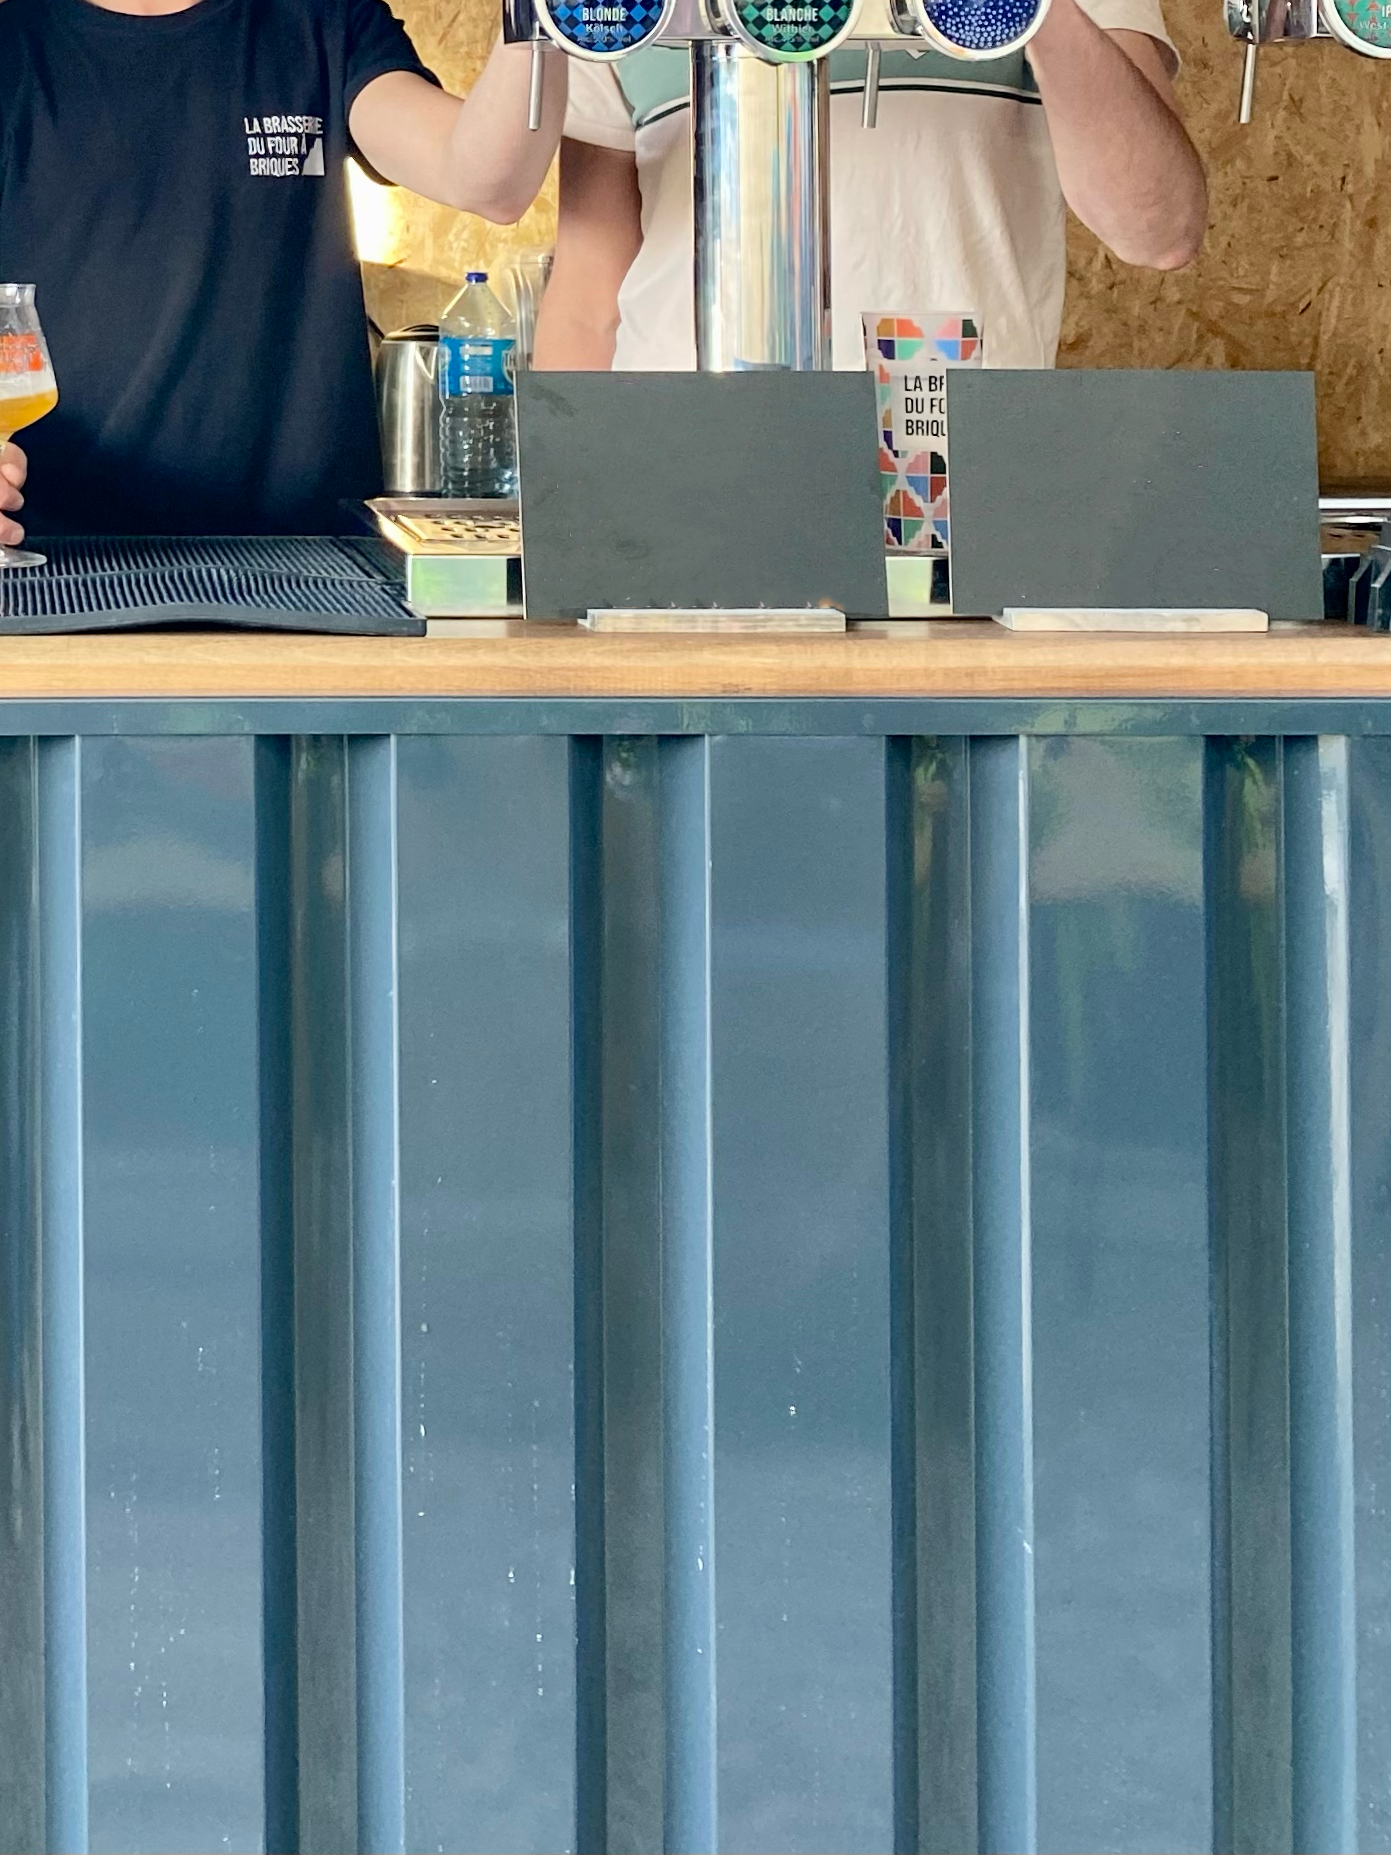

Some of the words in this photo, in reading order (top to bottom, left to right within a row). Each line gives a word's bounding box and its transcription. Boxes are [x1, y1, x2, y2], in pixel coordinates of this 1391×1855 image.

[582, 8, 627, 22] BLONDE
[766, 8, 819, 22] BLANCHE
[244, 117, 262, 134] LA
[248, 136, 265, 155] DU
[267, 136, 299, 155] FOUR
[249, 157, 300, 177] BRIQUES
[904, 375, 924, 392] LA
[905, 397, 924, 414] DU
